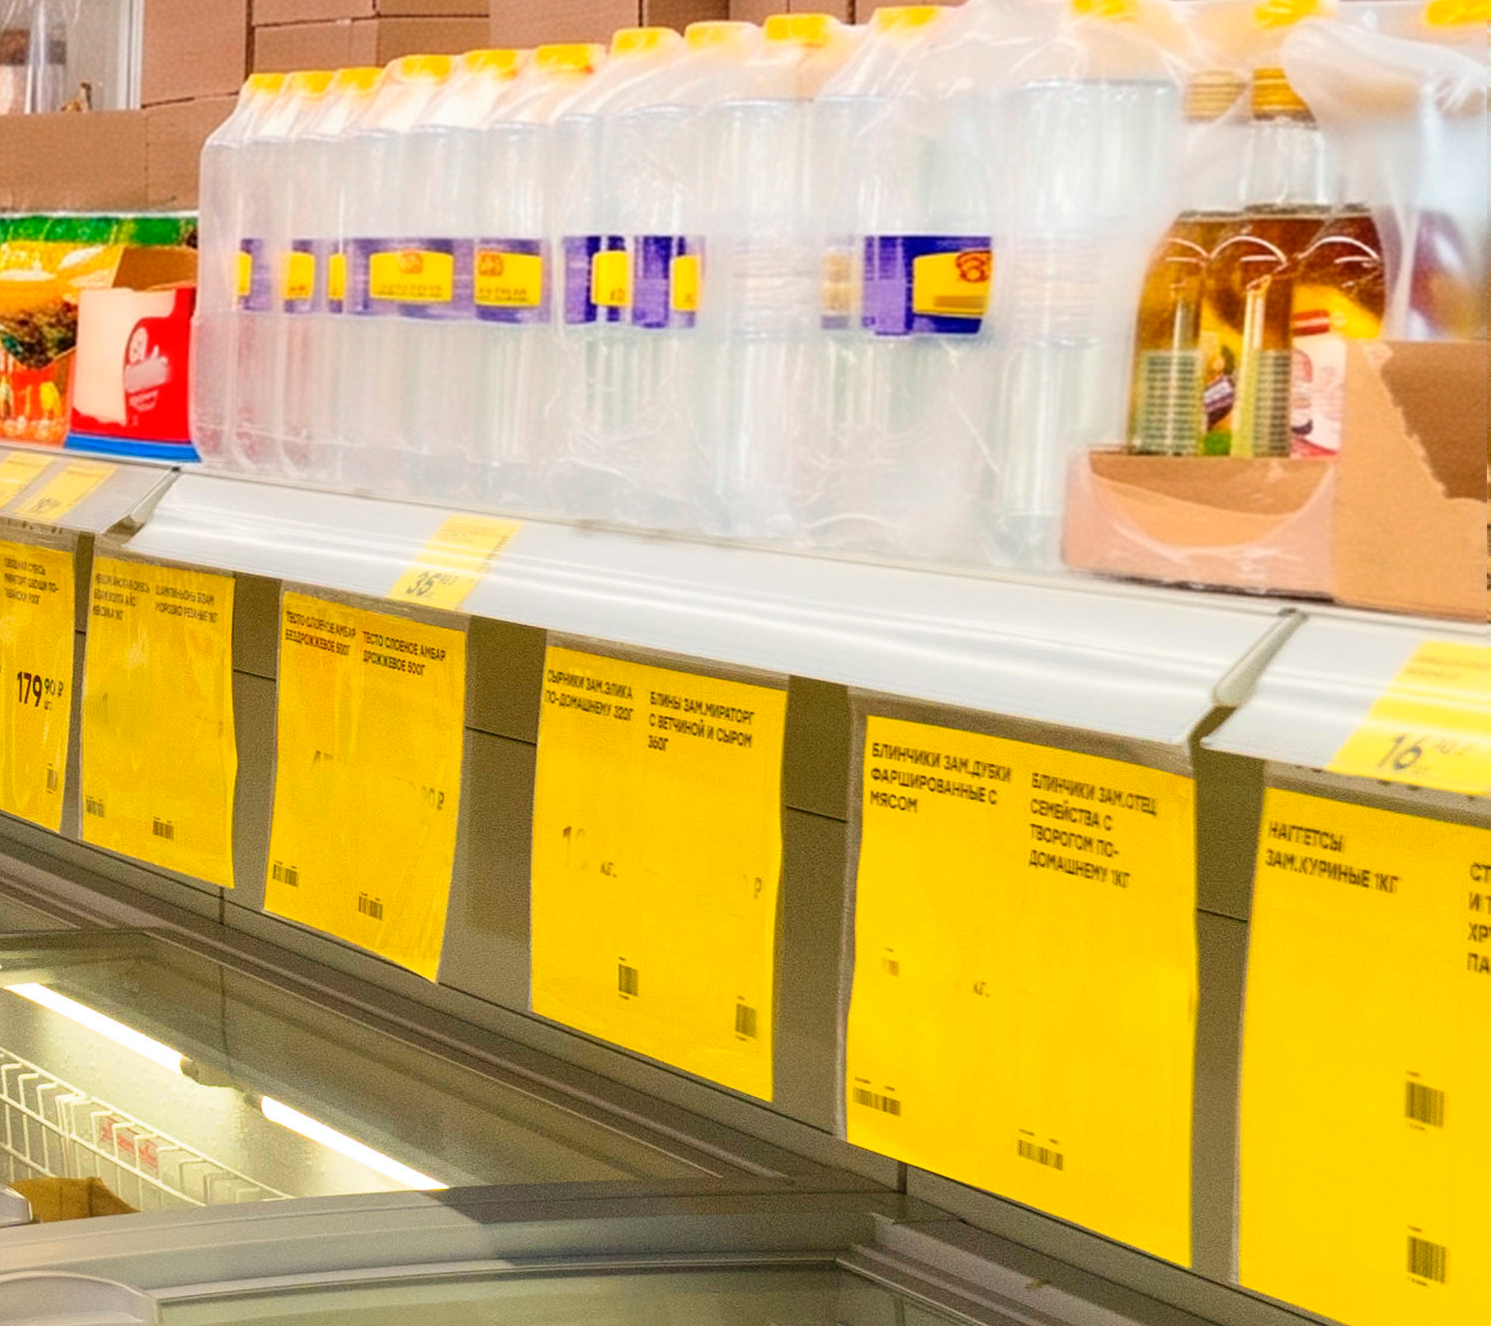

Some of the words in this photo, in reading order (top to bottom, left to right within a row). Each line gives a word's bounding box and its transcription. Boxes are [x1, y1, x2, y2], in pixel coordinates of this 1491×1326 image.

[406, 571, 439, 596] 35
[285, 628, 335, 653] БЕЗДРОЖЖЕВОЕ
[286, 610, 304, 626] ТЕСТО
[306, 614, 335, 635] СЛОЕНОЕ
[336, 623, 356, 639] АМБАР
[363, 630, 384, 647] ТЕСТО
[385, 637, 419, 656] СЛОЕНОЕ
[419, 644, 446, 661] АМБАР
[363, 650, 406, 672] ДРОЖЖЕВОЕ
[407, 661, 426, 676] 500Г
[17, 671, 43, 707] 179
[44, 677, 56, 696] 90
[547, 669, 584, 690] СЫРНИКИ
[585, 677, 633, 700] ЗАМ.ЭЛИКА
[544, 689, 612, 717] ПО-ДОМАШНЕМУ
[613, 705, 634, 722] 320Г
[649, 691, 682, 712] БЛИНЫ
[683, 697, 755, 725] ЗАМ.МИРАТОРГ
[647, 735, 669, 752] 360Г
[648, 713, 656, 727] С
[658, 714, 705, 740] ВЕТЧИНОЙ
[715, 727, 753, 748] СЫРОМ
[872, 742, 941, 767] БЛИНЧИКИ
[943, 754, 1011, 784] ЗАМ.ДУБКИ
[1379, 733, 1423, 771] 16
[870, 790, 918, 813] МЯСОМ
[871, 768, 985, 804] ФАРШИРОВАННЫЕ
[988, 789, 998, 806] С
[1031, 772, 1095, 801] БЛИНЧИКИ
[1097, 786, 1158, 816] ЗАМ.ОТЕЦ
[1030, 796, 1099, 827] СЕМЕЙСТВА
[1103, 814, 1113, 831] С
[1029, 823, 1093, 853] ТВОРОГОМ
[1096, 839, 1120, 858] ПО-
[1268, 821, 1344, 853] НАГГЕТСЫ
[1029, 849, 1108, 883] ДОМАШНЕМУ
[1111, 870, 1131, 889] 1КГ
[1265, 848, 1370, 889] ЗАМ.КУРИНЫЕ
[1374, 873, 1400, 894] 1КГ
